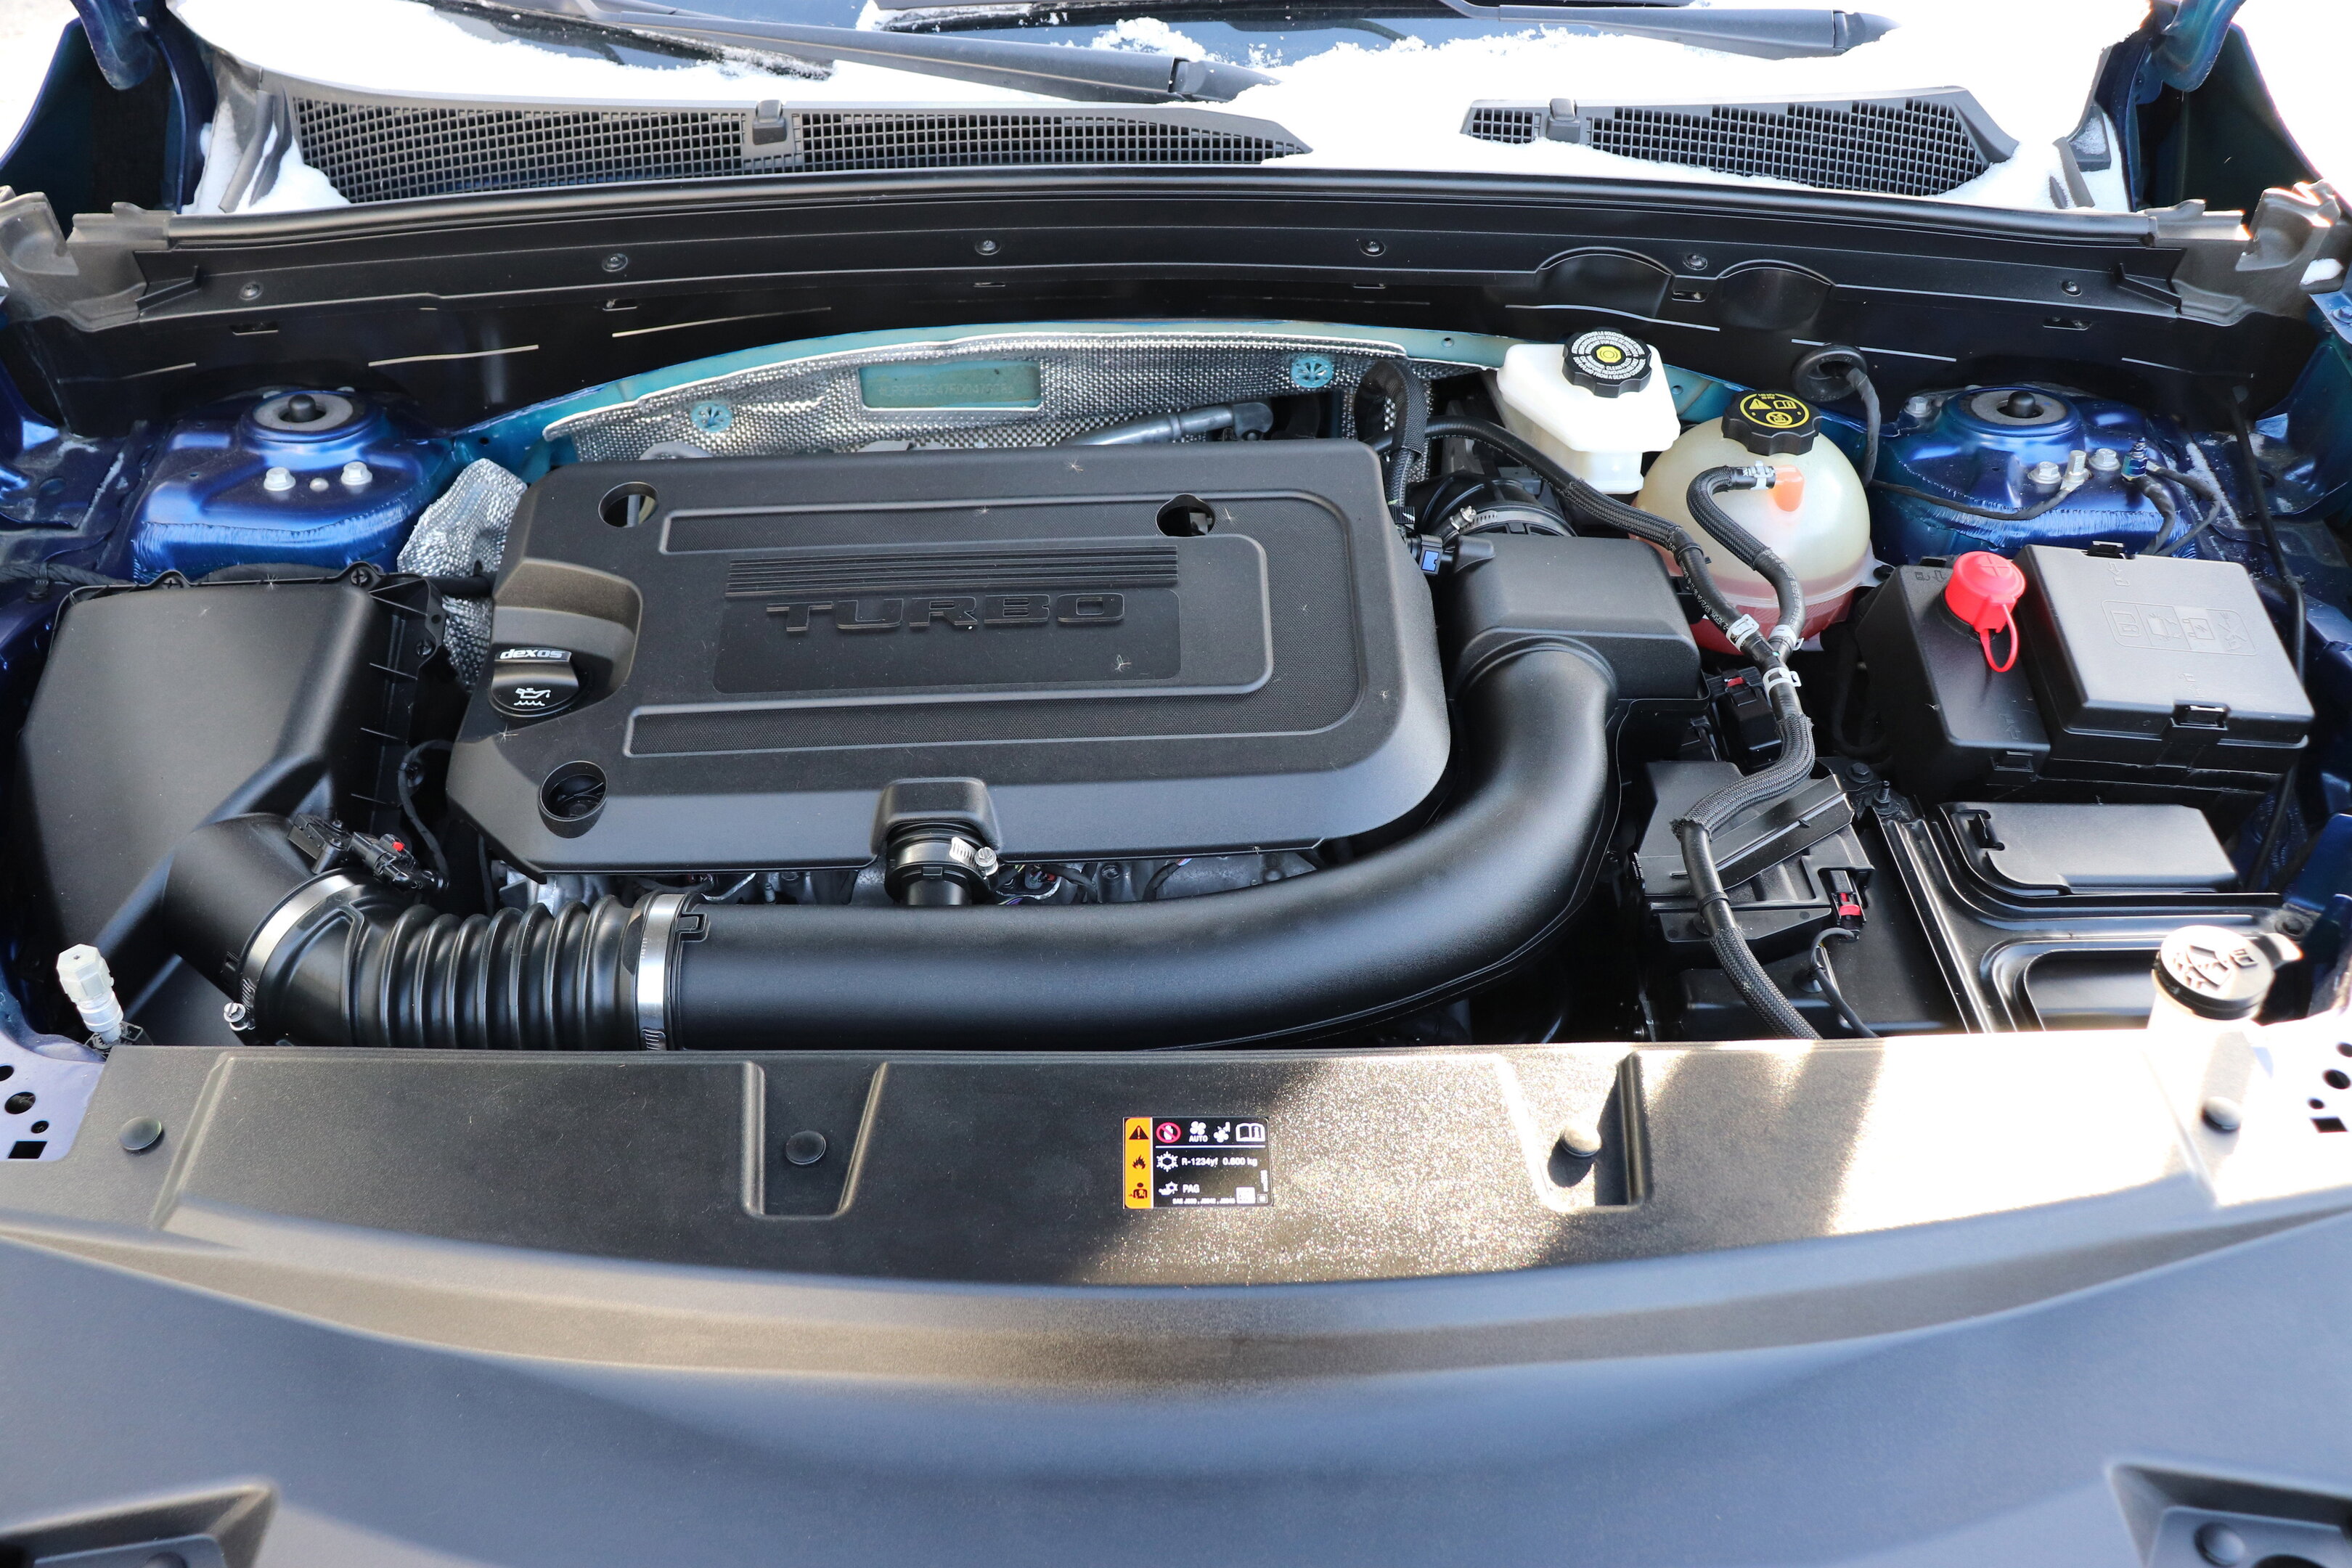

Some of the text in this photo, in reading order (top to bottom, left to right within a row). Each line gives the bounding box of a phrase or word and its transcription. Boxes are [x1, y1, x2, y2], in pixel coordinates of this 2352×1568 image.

[765, 592, 1126, 633] TURBO
[499, 648, 563, 660] dexos
[1181, 1157, 1218, 1167] R-1234yf
[1247, 1156, 1258, 1167] kg
[1183, 1184, 1200, 1193] PAG
